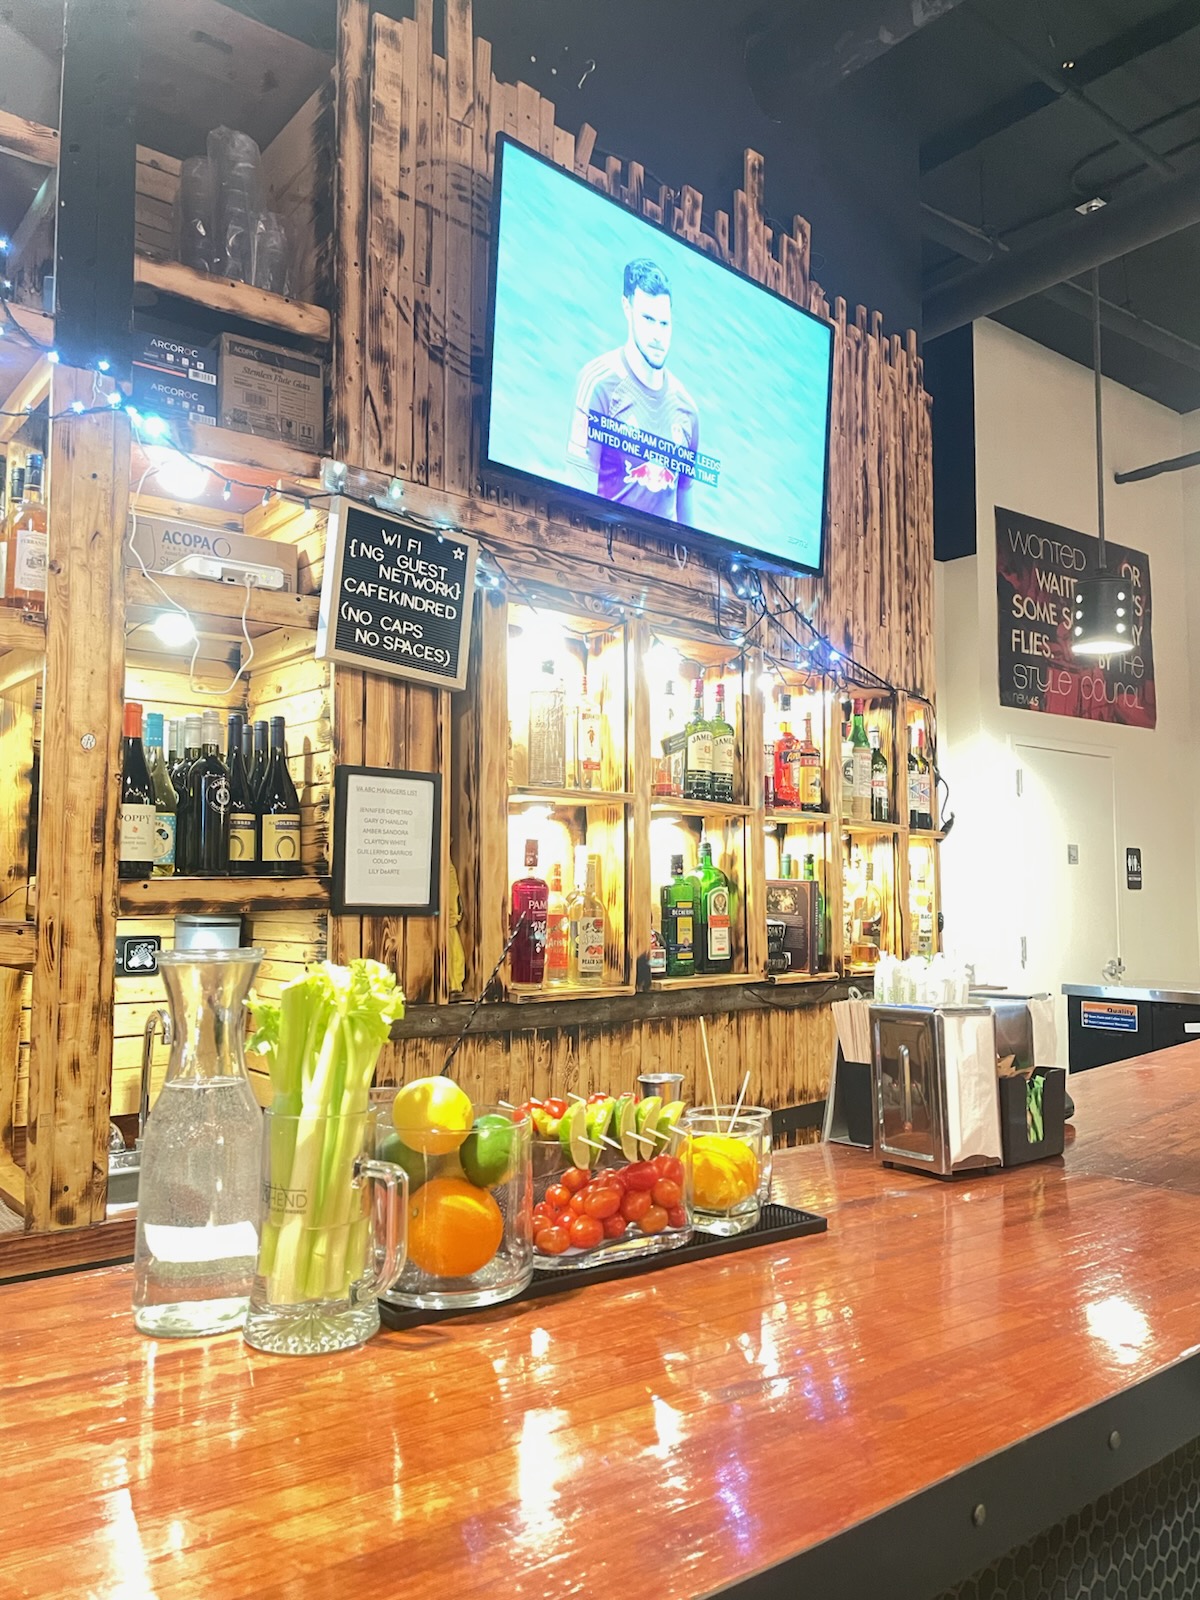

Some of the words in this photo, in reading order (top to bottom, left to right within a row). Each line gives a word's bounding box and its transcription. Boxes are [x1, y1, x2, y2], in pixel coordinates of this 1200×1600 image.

[150, 339, 198, 358] ARCOROC
[150, 383, 199, 401] ARCOROC
[588, 427, 621, 448] UNITED
[622, 440, 642, 456] ONE.
[643, 449, 670, 468] AFTER
[671, 460, 696, 478] EXTRA
[601, 417, 657, 447] BIRMINGHAM
[658, 440, 677, 455] CITY
[697, 455, 720, 471] LEEDS
[162, 530, 211, 550] ACOPA
[381, 529, 401, 549] WI
[407, 538, 422, 555] FI
[379, 564, 462, 601] NETWORK}
[397, 555, 449, 581] GUEST
[343, 577, 457, 620] CAFEKINDRED
[1011, 594, 1058, 626] SOME
[341, 601, 373, 626] (NO
[379, 616, 424, 639] CAPS
[355, 628, 380, 647] NO
[383, 635, 451, 667] SPACES)
[1011, 629, 1055, 660] FLIES.
[1107, 1007, 1134, 1016] Quality
